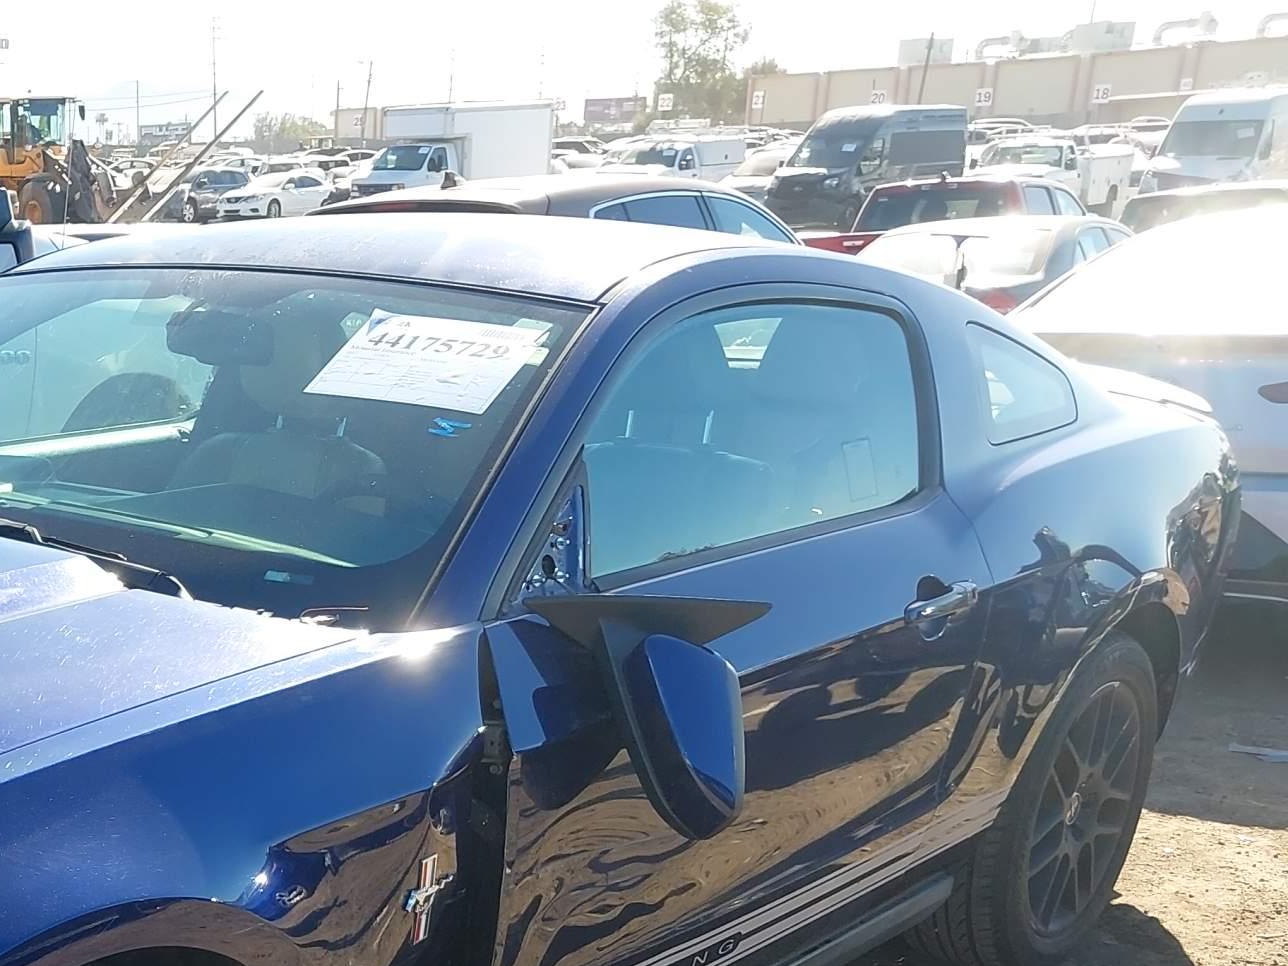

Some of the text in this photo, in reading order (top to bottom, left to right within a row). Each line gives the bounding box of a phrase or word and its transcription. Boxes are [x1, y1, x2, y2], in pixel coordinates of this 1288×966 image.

[871, 92, 886, 104] 20
[976, 91, 992, 103] 19
[1095, 87, 1110, 100] 18
[367, 331, 511, 360] 44175729
